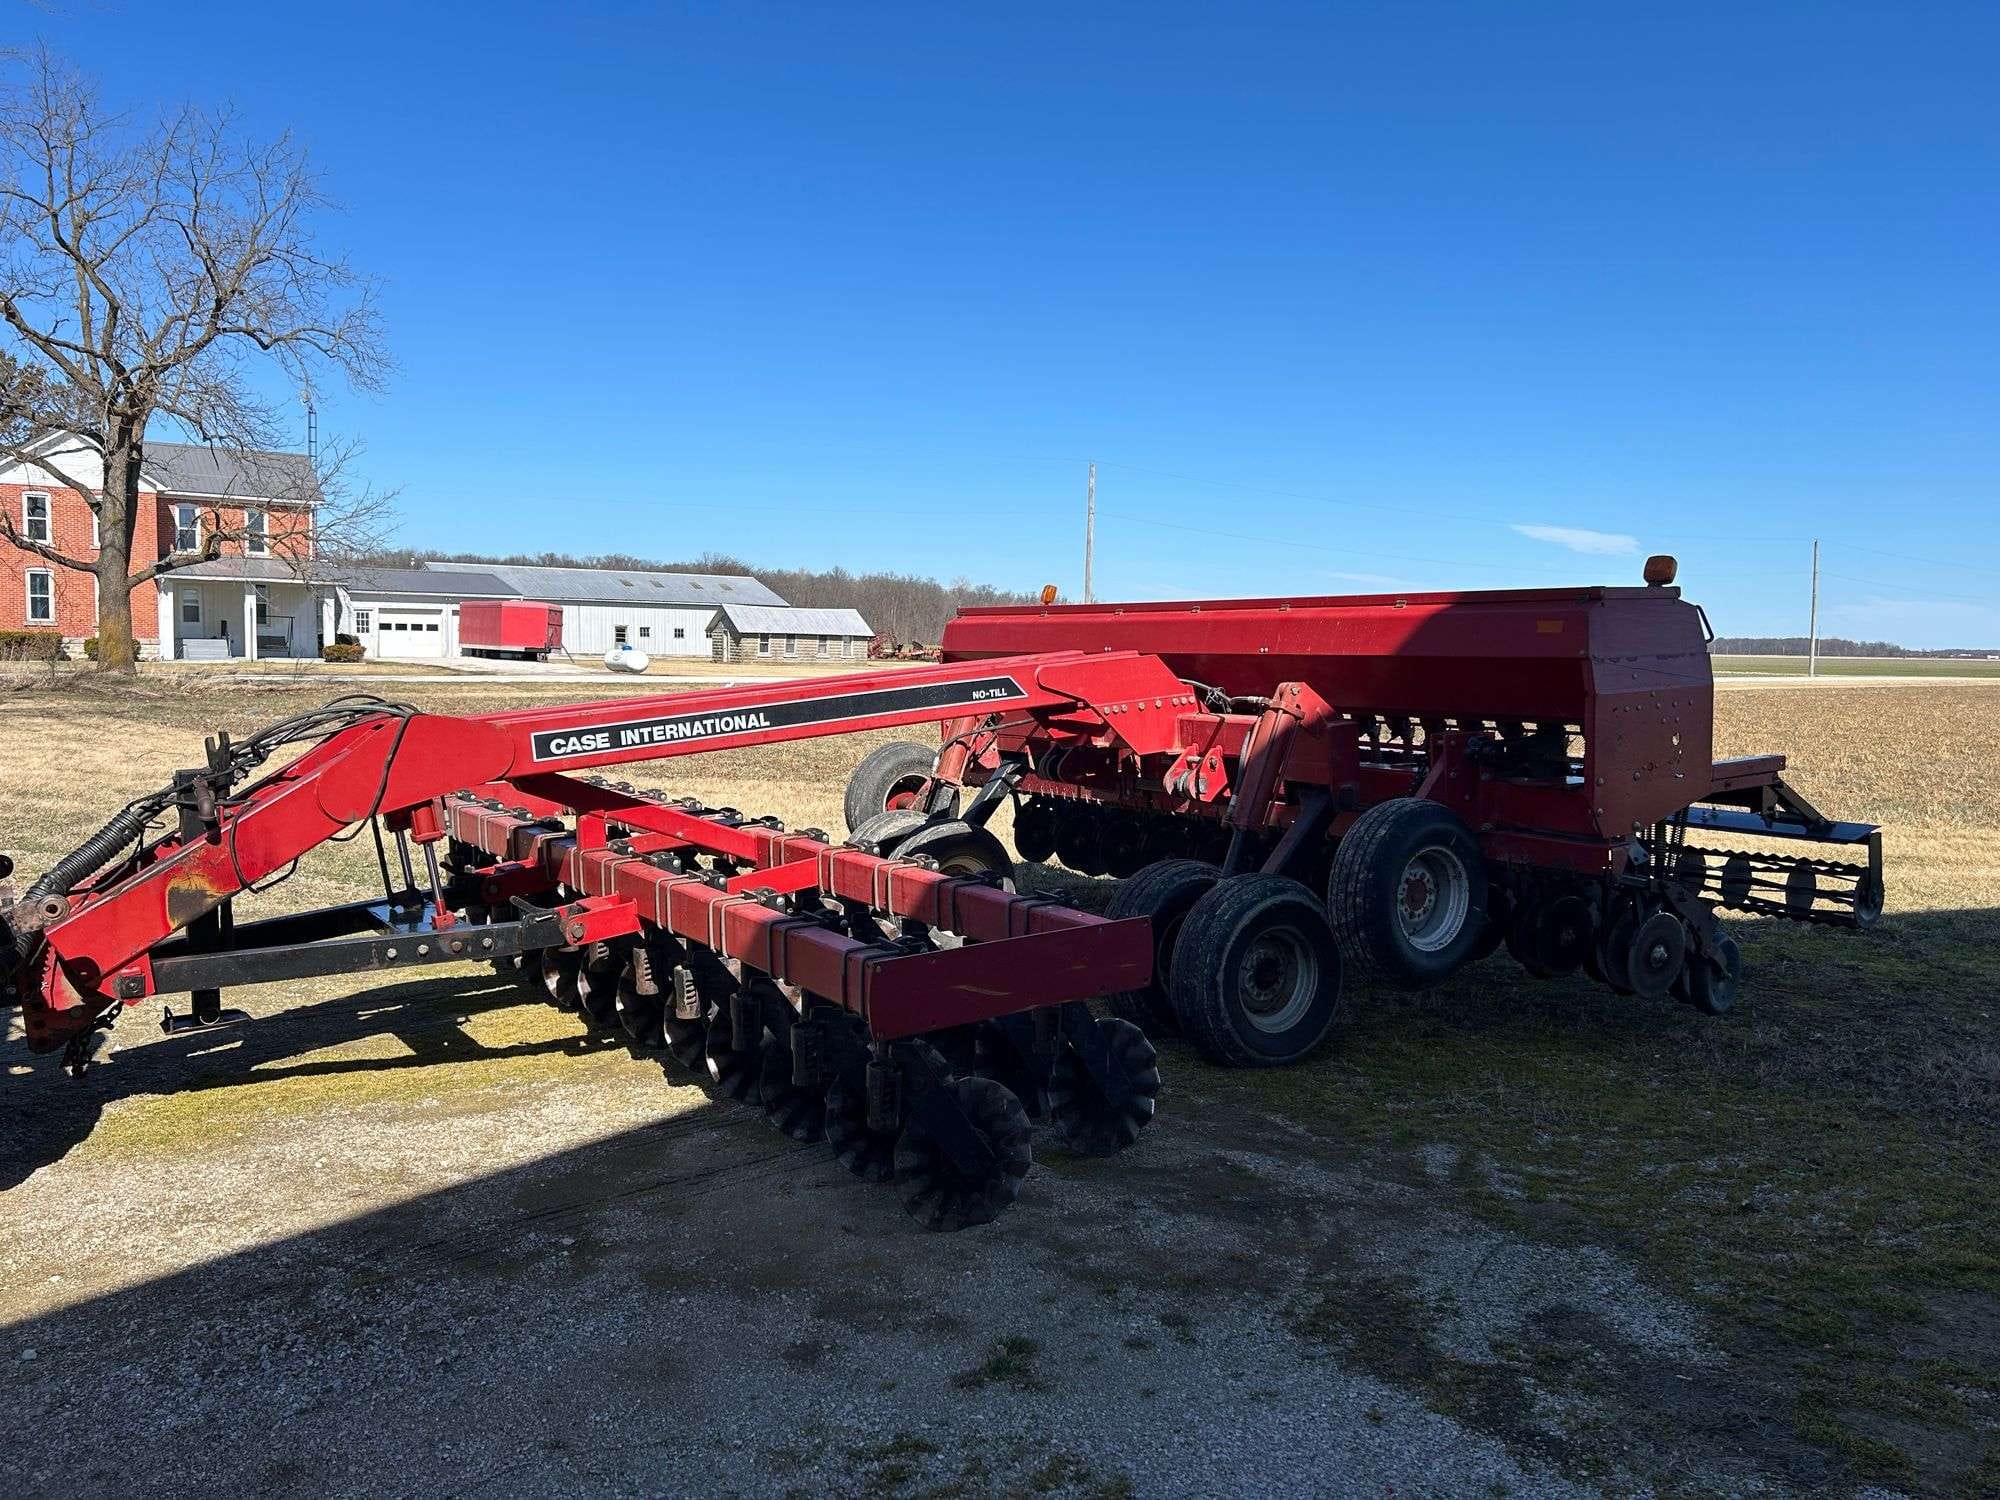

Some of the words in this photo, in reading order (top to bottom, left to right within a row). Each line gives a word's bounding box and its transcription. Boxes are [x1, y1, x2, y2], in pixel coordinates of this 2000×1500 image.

[972, 687, 1008, 700] NO-TILL
[549, 732, 610, 755] CASE
[619, 712, 771, 746] INTERNATIONAL
